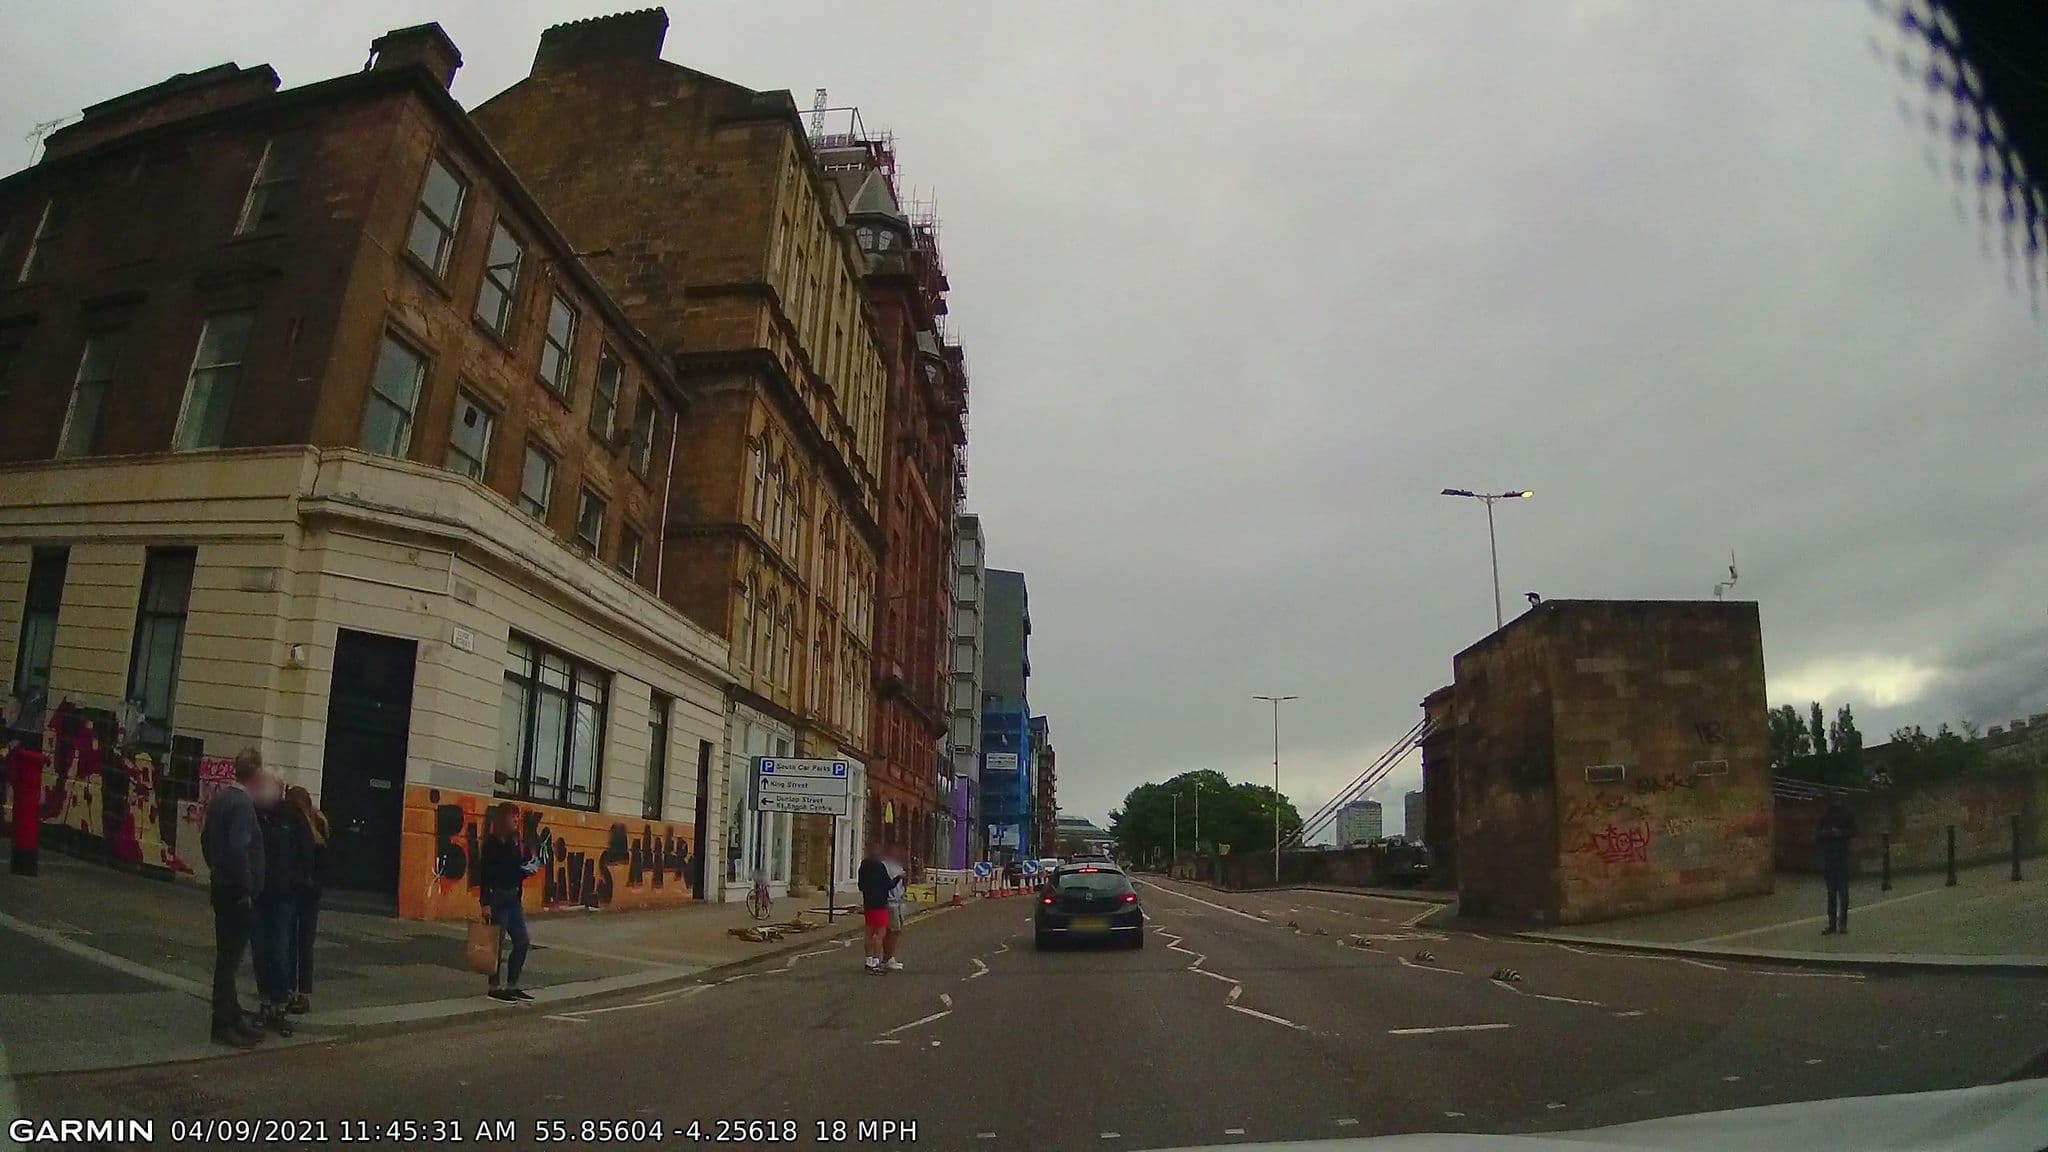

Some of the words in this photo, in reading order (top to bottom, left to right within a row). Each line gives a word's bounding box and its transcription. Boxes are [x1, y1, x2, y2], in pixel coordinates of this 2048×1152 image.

[776, 762, 796, 771] South
[770, 780, 785, 788] King
[787, 781, 808, 789] Street
[776, 795, 799, 803] Dunlop
[802, 796, 823, 804] Street
